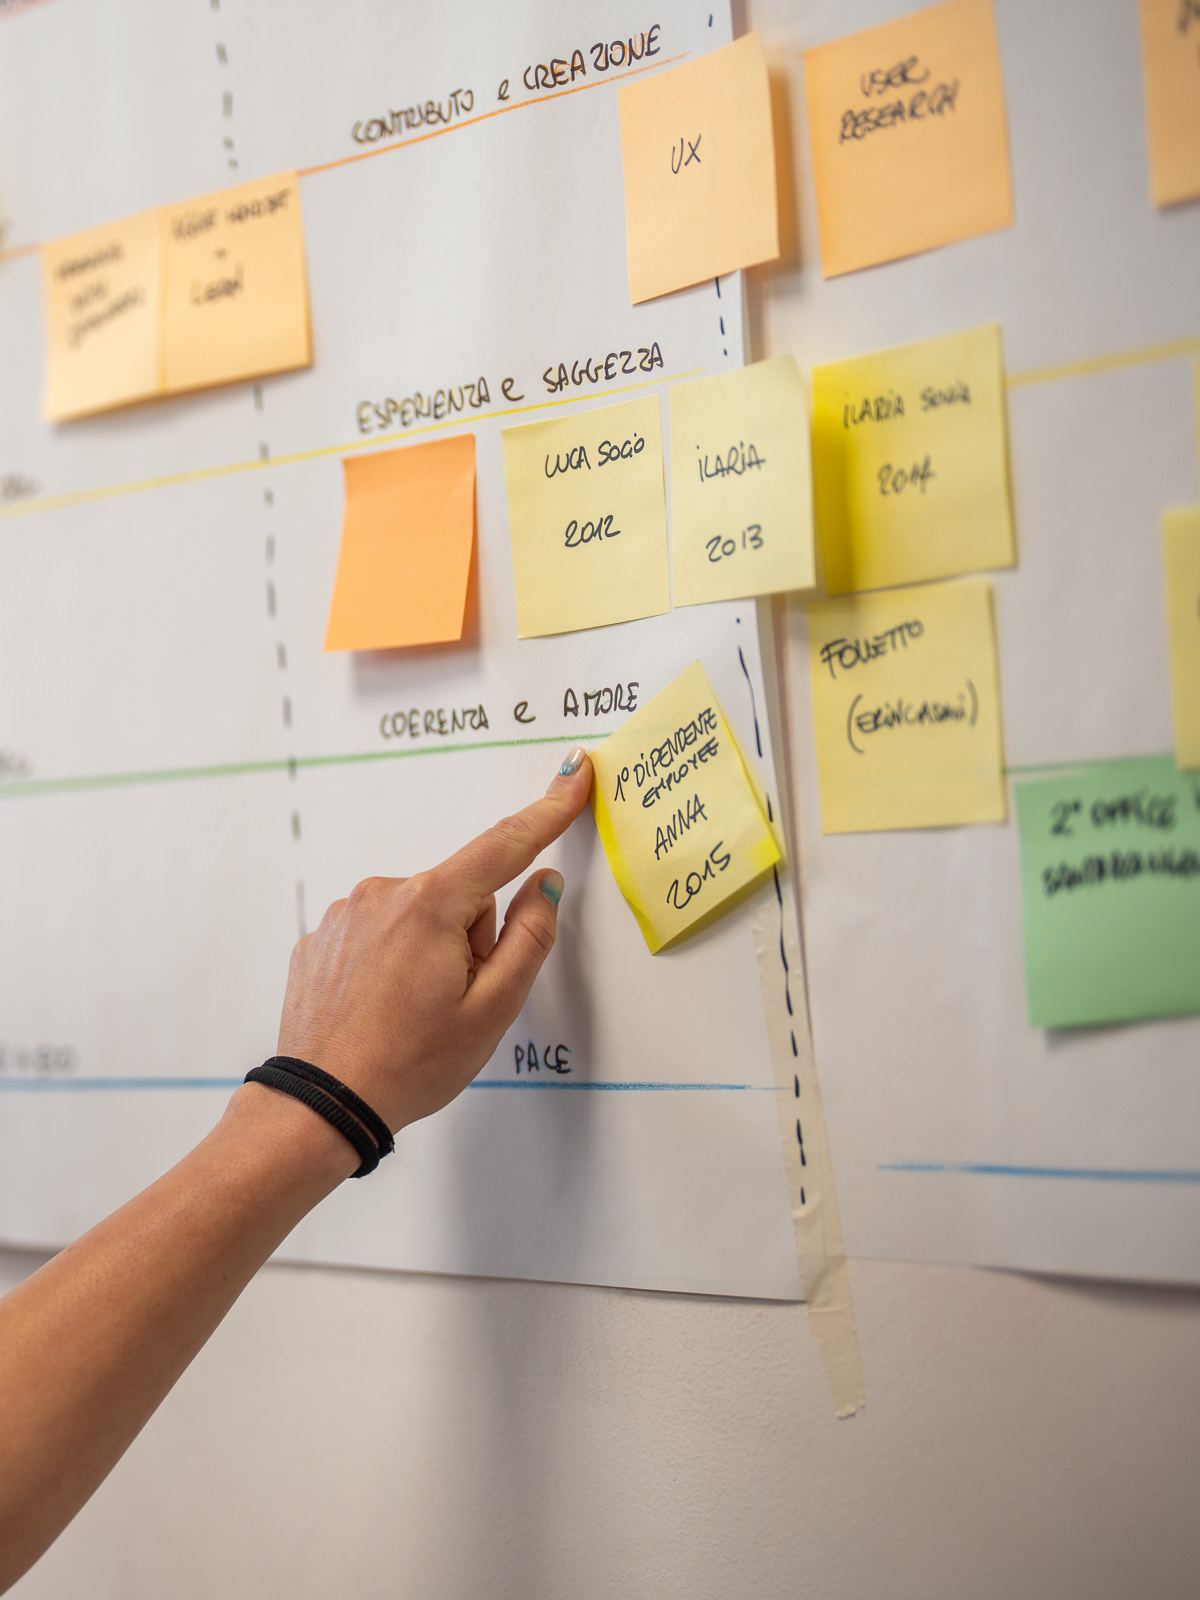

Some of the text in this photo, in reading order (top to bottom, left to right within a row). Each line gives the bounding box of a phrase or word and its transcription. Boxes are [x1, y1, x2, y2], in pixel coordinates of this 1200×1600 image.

[352, 24, 660, 145] CONTRIBUTO e CREAZIONE
[859, 55, 931, 98] USER
[671, 133, 702, 174] UX
[356, 342, 664, 435] ESPERIENZA e SAGGEZZA
[545, 445, 591, 479] LUCA
[876, 452, 938, 497] 2014
[564, 514, 621, 548] 2012
[705, 523, 765, 563] 2013
[819, 618, 926, 681] FOLLETTO
[379, 681, 640, 741] COERENZA e AMORE
[641, 736, 720, 809] EMPLOYEE
[654, 793, 709, 861] ANNA
[665, 840, 732, 910] 2015
[514, 1041, 572, 1076] PACE
